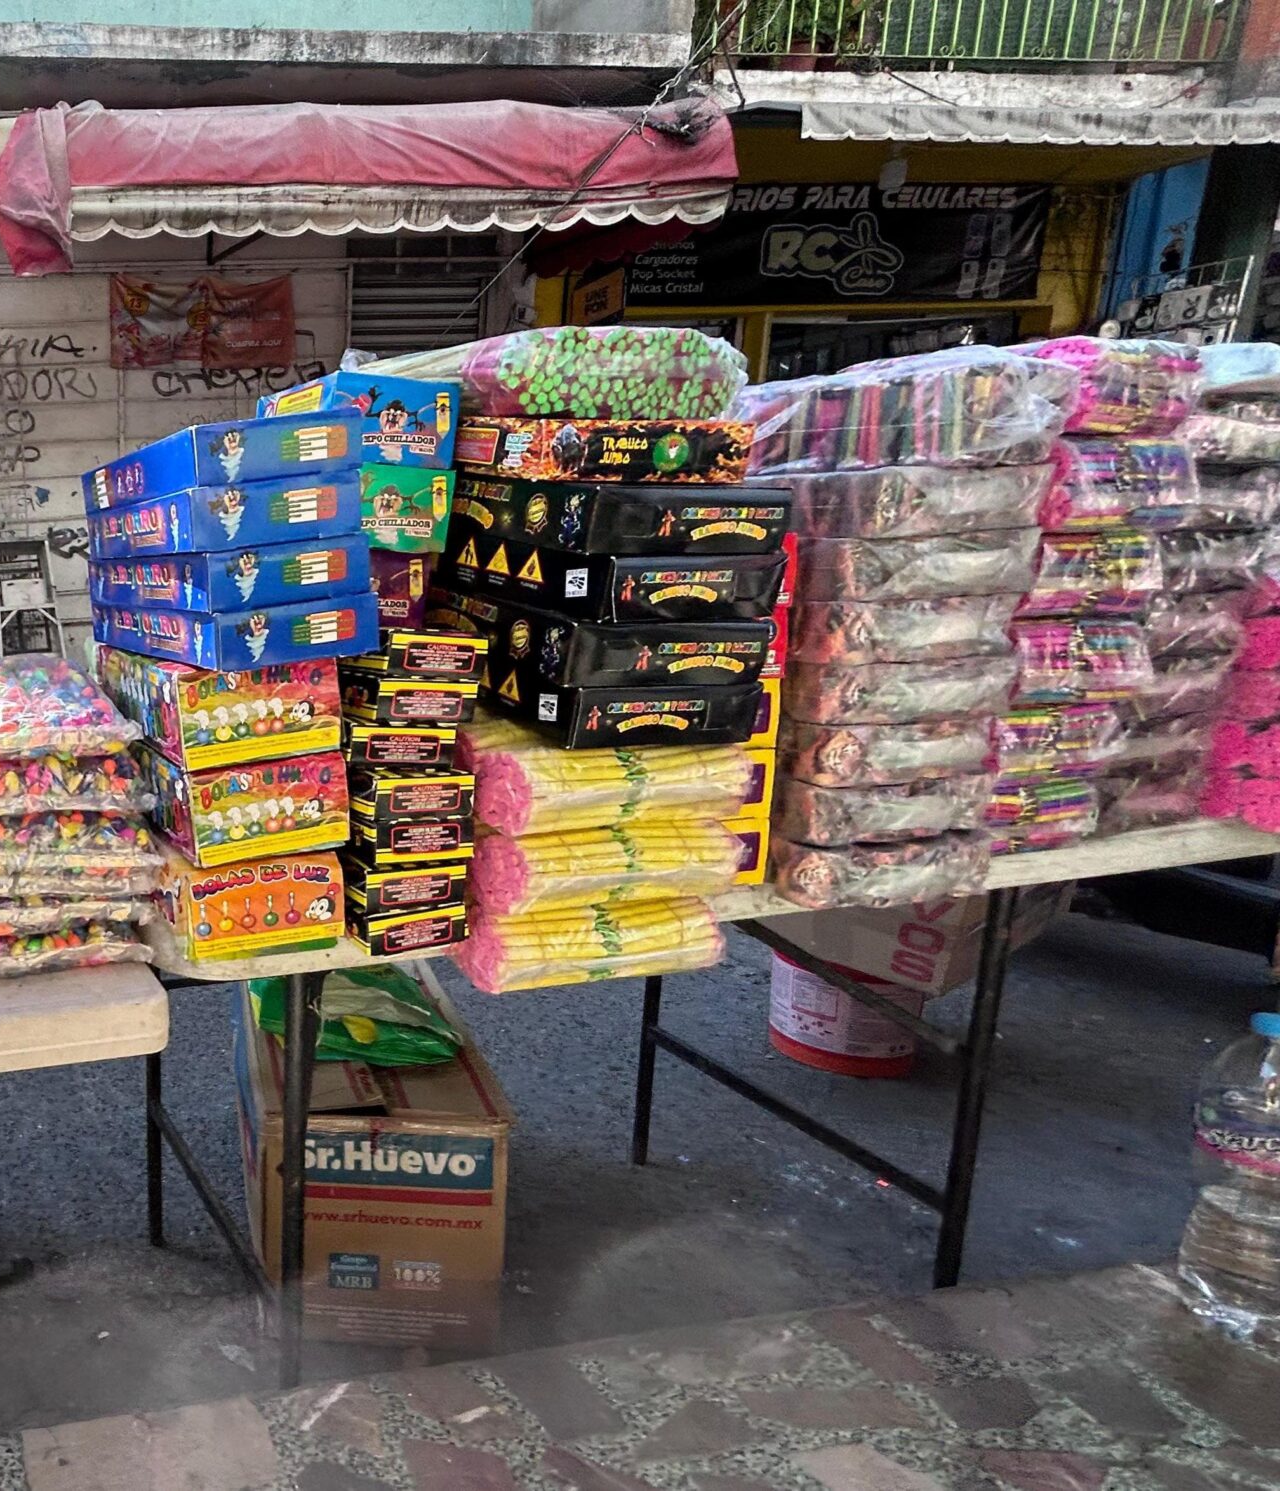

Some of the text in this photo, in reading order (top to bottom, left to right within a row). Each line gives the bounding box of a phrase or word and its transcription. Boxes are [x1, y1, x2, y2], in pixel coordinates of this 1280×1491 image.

[730, 185, 1018, 211] RIOS PARA CELULARES
[634, 254, 699, 266] Cargadores
[632, 269, 696, 280] Pop Socket
[629, 282, 704, 294] Micas Cristal
[383, 434, 435, 445] CHILLADOR
[601, 437, 649, 450] TRABUCO
[378, 518, 431, 529] CHILLADOR
[377, 600, 408, 609] LADOR
[191, 863, 331, 900] BOLAS DE LUZ
